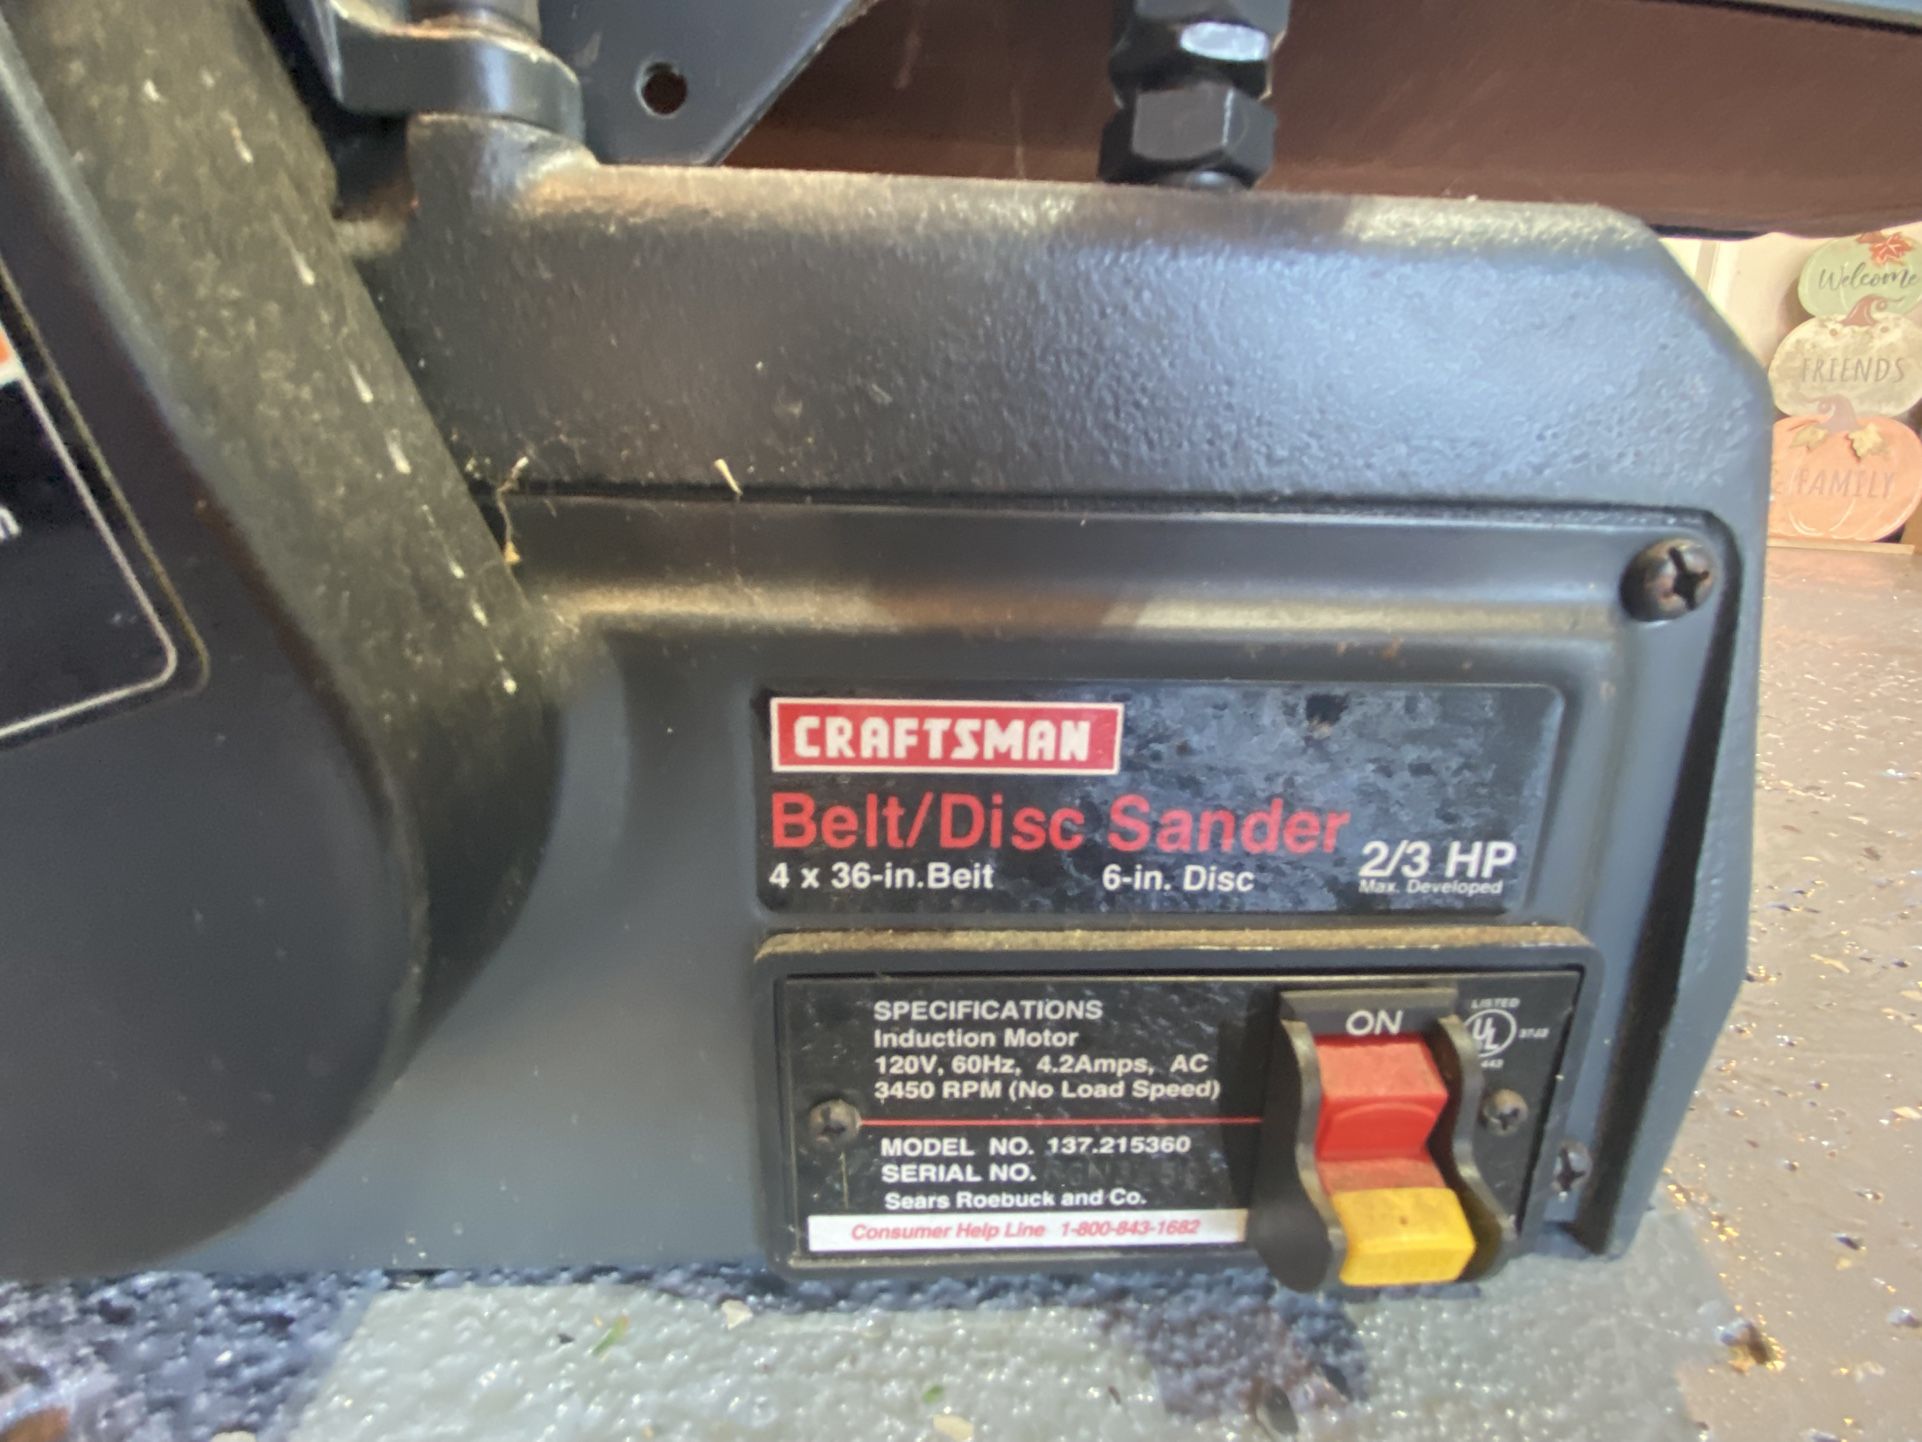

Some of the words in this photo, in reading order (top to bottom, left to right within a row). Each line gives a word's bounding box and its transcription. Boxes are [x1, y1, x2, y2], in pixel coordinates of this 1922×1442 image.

[1818, 262, 1919, 291] Welcome
[1801, 357, 1905, 384] FRIENDS
[1796, 467, 1896, 499] FAMILY
[794, 716, 1091, 761] CRAFTSMAN
[771, 791, 1085, 850] Belt/Disc
[1107, 794, 1351, 854] Sander
[1359, 840, 1432, 879] 2/3
[1445, 841, 1517, 879] HP
[769, 862, 790, 889] 4
[801, 868, 819, 888] x
[1102, 864, 1171, 891] 6-in.
[1183, 865, 1256, 892] Disc
[1359, 880, 1400, 894] Max.
[1406, 880, 1504, 897] Developed
[873, 1000, 1104, 1021] SPECIFICATIONS
[1470, 997, 1521, 1010] LISTED
[1345, 1009, 1404, 1036] ON
[1471, 1017, 1500, 1051] UL
[873, 1029, 996, 1048] Induction
[1003, 1028, 1079, 1047] Motor
[874, 1055, 944, 1076] 120V,
[951, 1055, 1022, 1076] 60Hz,
[1036, 1054, 1155, 1078] 4.2Amps,
[1169, 1053, 1209, 1073] AC
[874, 1081, 935, 1099] 3450
[942, 1081, 1001, 1098] RPM
[1009, 1080, 1054, 1101] (No
[1061, 1080, 1125, 1098] Load
[1131, 1079, 1221, 1101] Speed)
[881, 1137, 975, 1157] MODEL
[989, 1137, 1035, 1156] NO.
[1047, 1136, 1192, 1154] 137.215360
[881, 1164, 982, 1183] SERIAL
[989, 1163, 1037, 1182] NO.
[884, 1191, 951, 1210] Sears
[956, 1189, 1056, 1209] Roebuck
[1061, 1188, 1104, 1206] and
[1108, 1187, 1147, 1205] Co.
[851, 1223, 952, 1241] Consumer
[956, 1221, 1001, 1242] Help
[1004, 1221, 1045, 1238] Line
[1061, 1218, 1201, 1237] 1-800-843-1682
